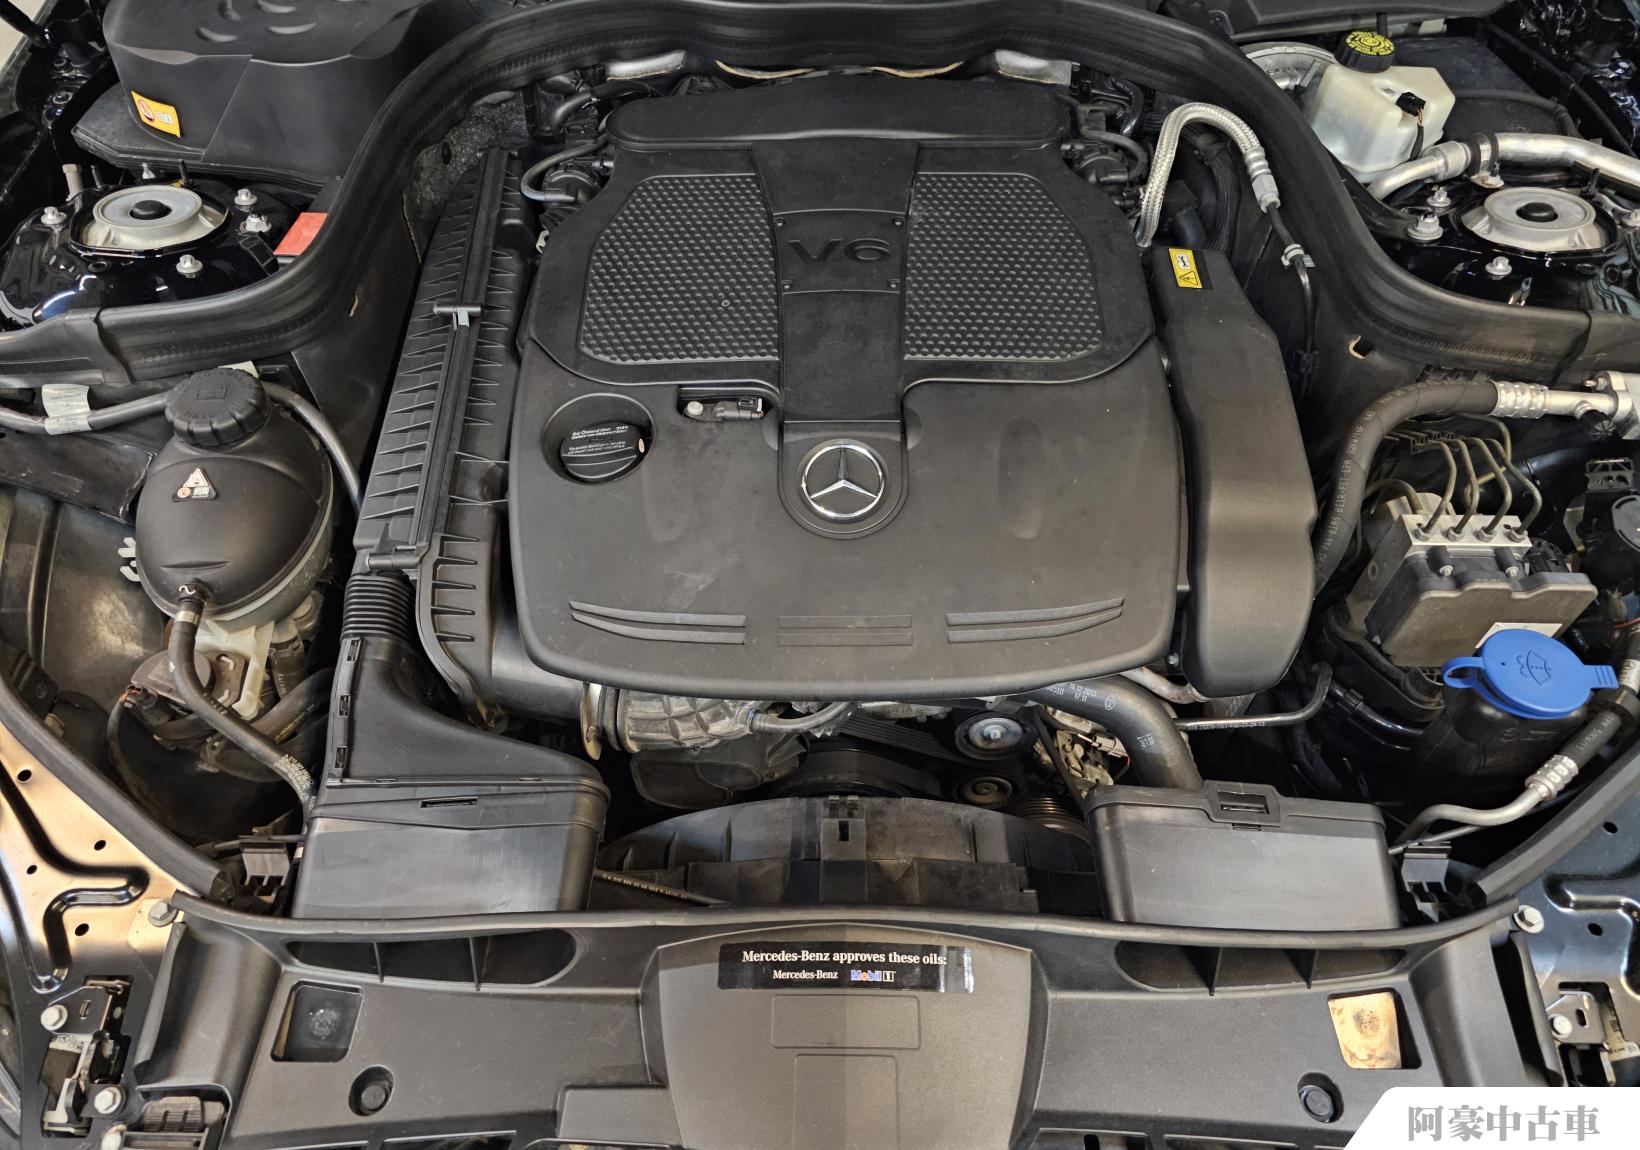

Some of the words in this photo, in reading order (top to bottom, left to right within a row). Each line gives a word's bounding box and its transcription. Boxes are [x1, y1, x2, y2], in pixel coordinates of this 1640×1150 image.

[786, 238, 890, 262] V6
[742, 950, 830, 963] Mercedes-Benz
[832, 951, 886, 964] approves
[888, 952, 920, 964] these
[922, 953, 948, 965] oils:
[772, 969, 838, 980] Mercedes-Benz
[850, 970, 882, 981] Mobil
